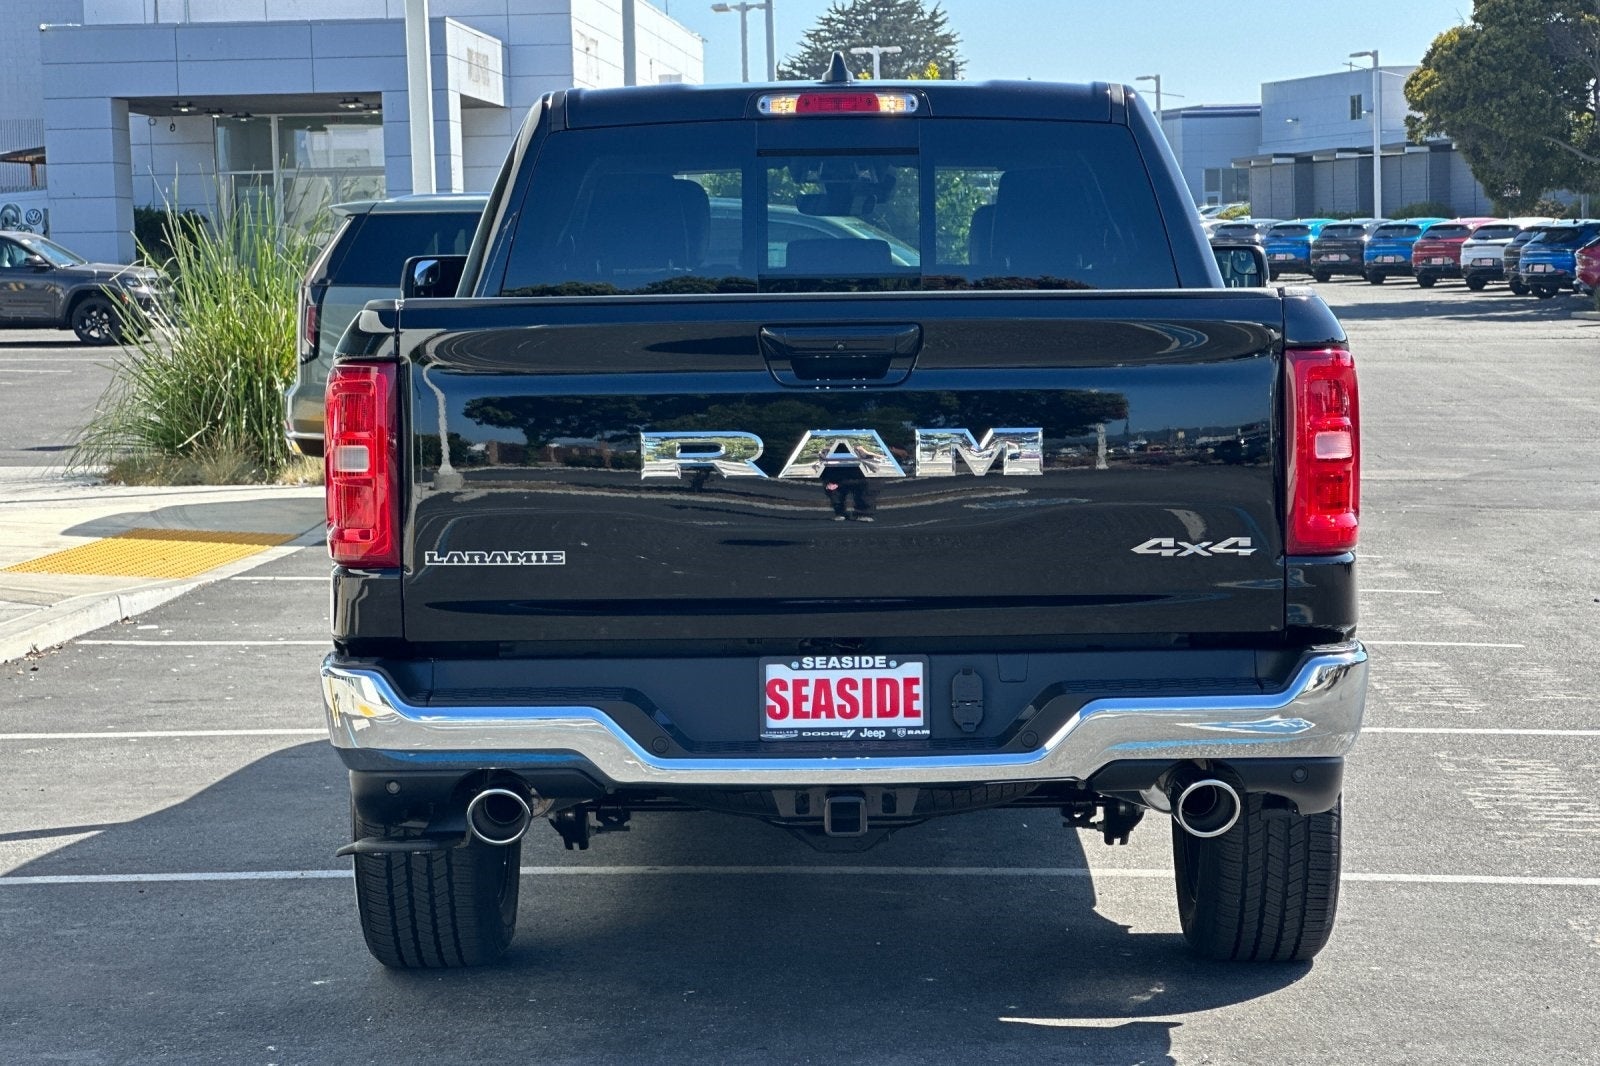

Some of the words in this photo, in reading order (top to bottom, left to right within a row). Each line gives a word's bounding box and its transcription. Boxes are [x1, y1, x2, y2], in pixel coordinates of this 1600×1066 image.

[640, 428, 1044, 479] RAM
[1130, 537, 1257, 557] 4x4
[424, 551, 566, 565] LARAMIE
[802, 656, 887, 669] SEASIDE
[766, 677, 921, 720] SEASIDE
[859, 728, 886, 739] Jeep
